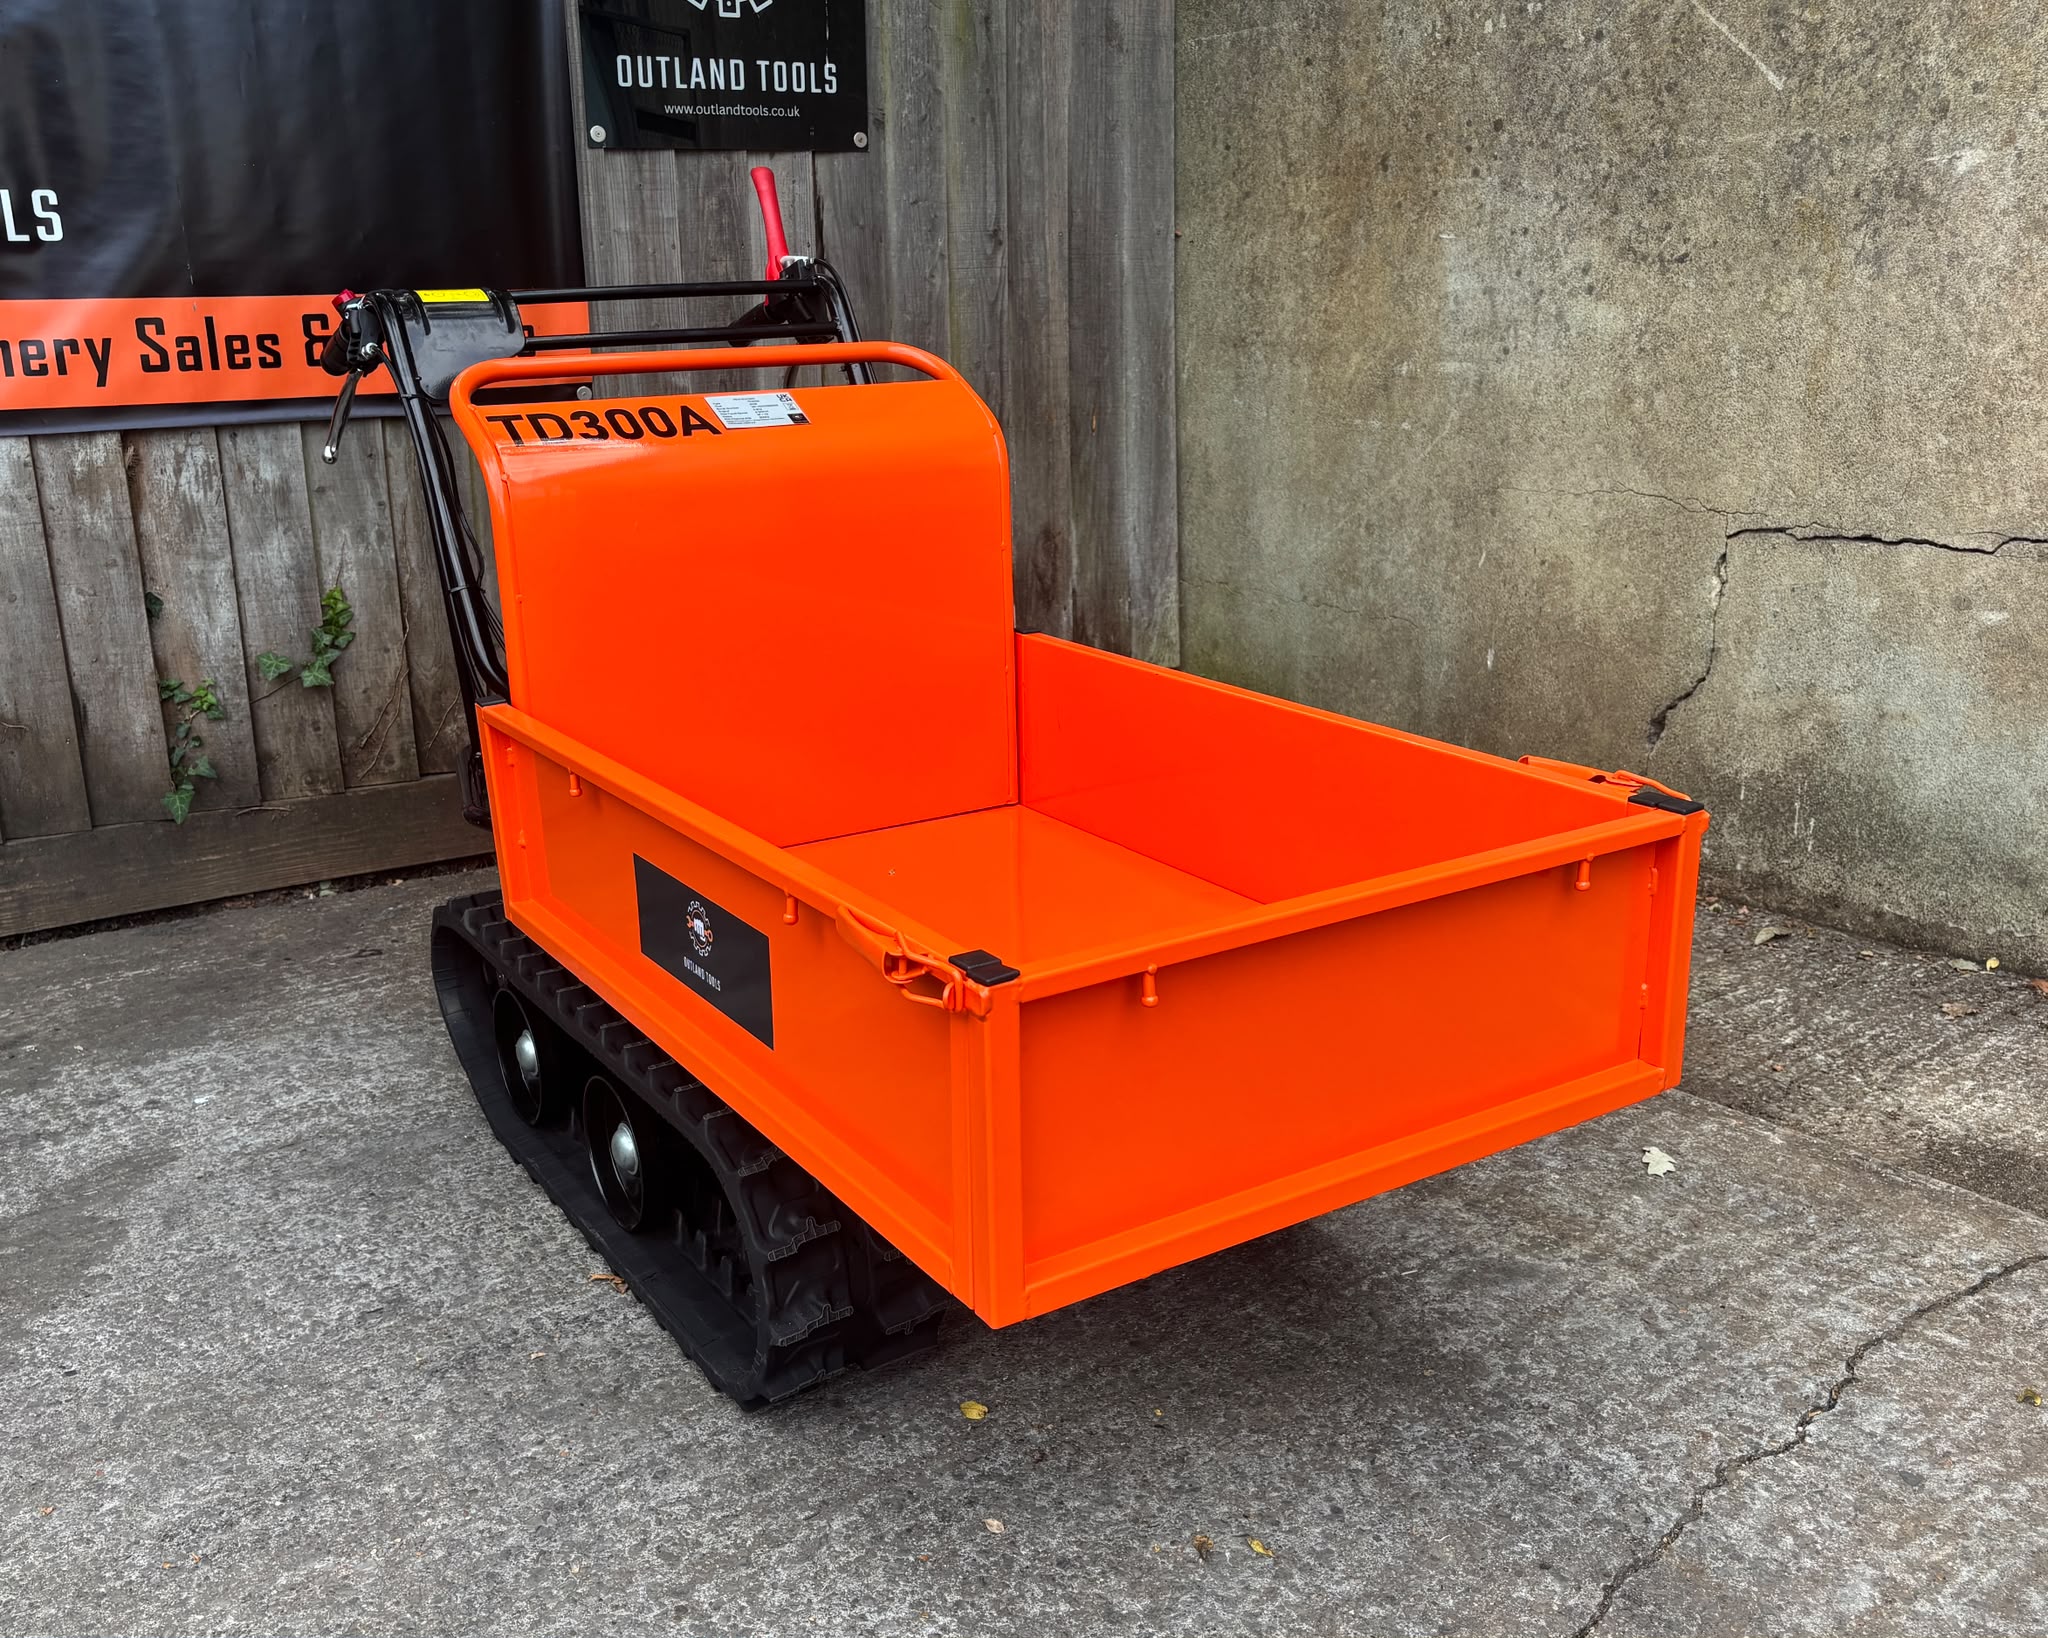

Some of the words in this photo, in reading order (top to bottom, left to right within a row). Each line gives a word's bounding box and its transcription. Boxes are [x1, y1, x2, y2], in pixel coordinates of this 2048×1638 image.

[616, 54, 746, 91] OUTLAND
[756, 60, 838, 94] TOOLS
[664, 103, 801, 118] www.outlandtools.co.uk
[135, 316, 283, 373] Sales
[485, 405, 722, 448] TD300A
[683, 956, 705, 980] OUTLAND
[705, 971, 721, 992] TOOLS
